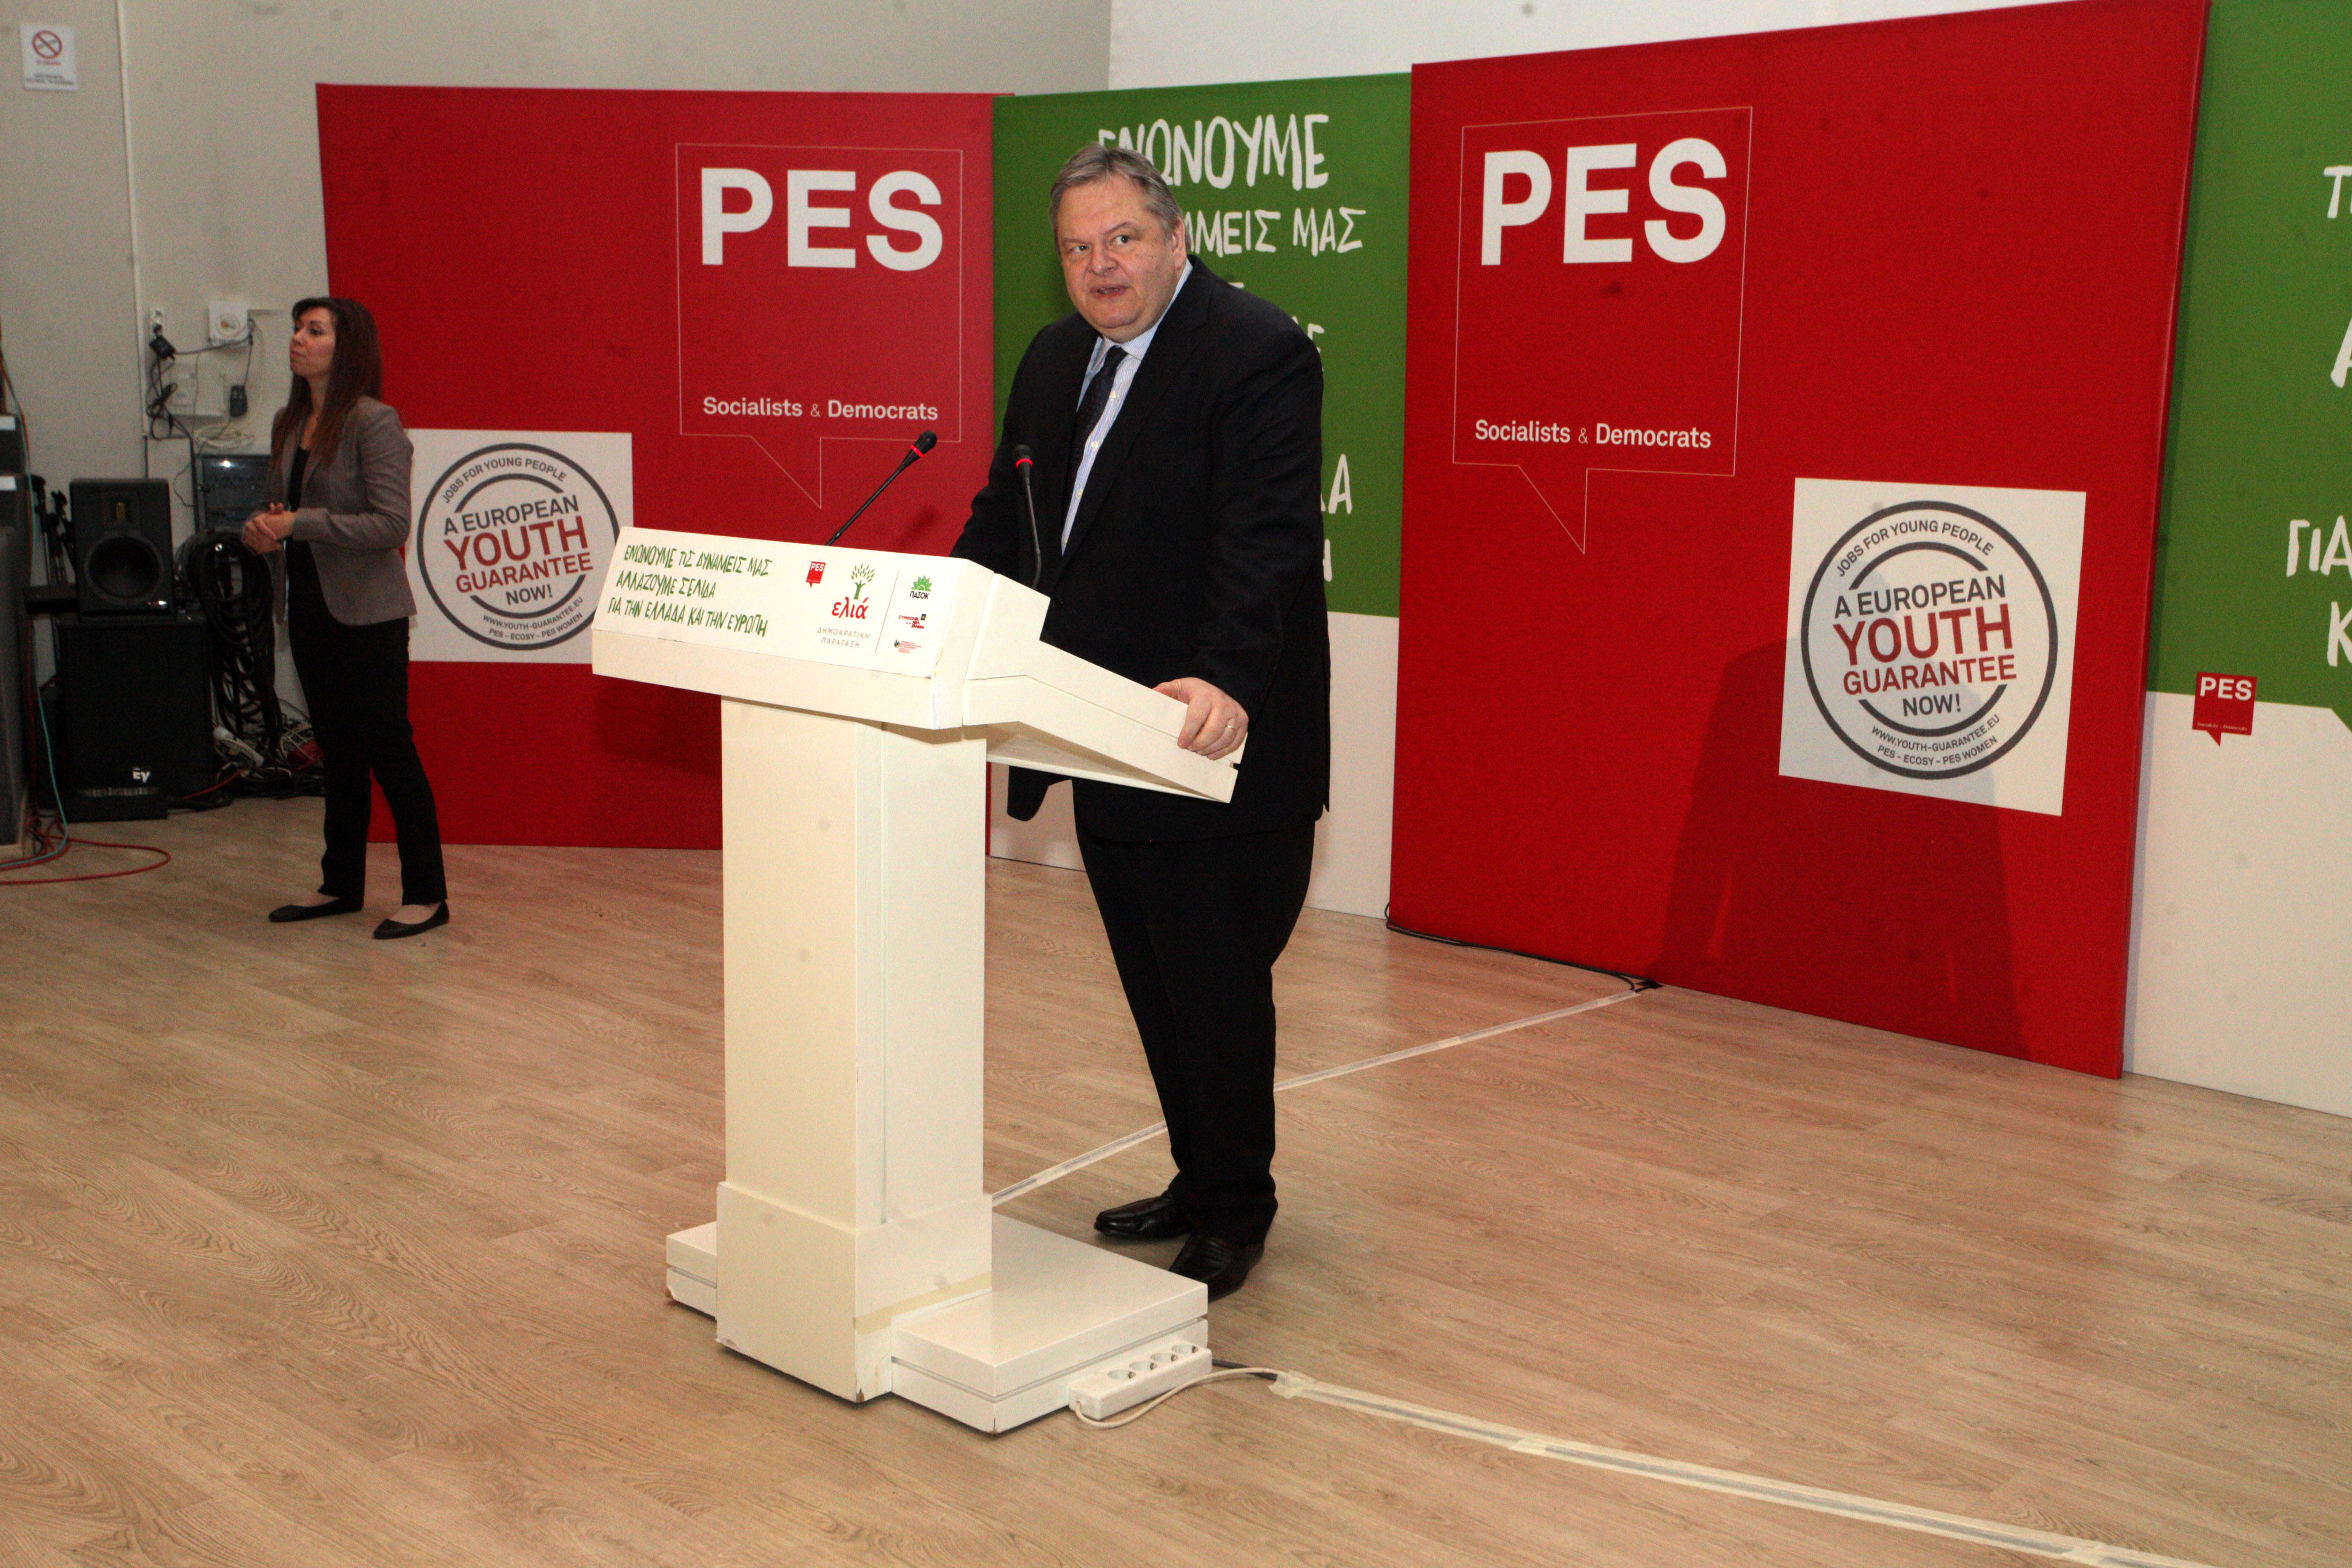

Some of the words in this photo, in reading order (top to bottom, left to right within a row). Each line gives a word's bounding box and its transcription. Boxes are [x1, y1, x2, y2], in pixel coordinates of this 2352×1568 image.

[1482, 138, 1727, 266] PES
[702, 168, 943, 272] PES
[1293, 207, 1366, 256] ΜΑΣ
[703, 397, 802, 417] Socialists
[811, 404, 821, 417] &
[828, 399, 938, 421] Democrats
[1475, 419, 1571, 443] Socialists
[1578, 428, 1589, 444] &
[1596, 423, 1712, 448] Democrats
[442, 478, 464, 503] JOBS
[462, 465, 484, 482] FOR
[483, 457, 522, 470] YOUNG
[525, 458, 567, 481] PEOPLE
[444, 518, 458, 536] A
[462, 495, 579, 532] EUROPEAN
[443, 515, 588, 571] YOUTH
[1837, 545, 1864, 576] JOBS
[1863, 528, 1890, 550] FOR
[1890, 520, 1938, 536] YOUNG
[1942, 522, 1994, 556] PEOPLE
[456, 552, 594, 593] GUARANTEE
[624, 544, 677, 568] ΕΝΩΝΟΥΜΕ
[696, 552, 747, 574] ΔΥΝΑΜΕΙΣ
[747, 557, 773, 577] ΜΑΣ
[811, 563, 825, 571] PES
[506, 584, 553, 605] NOW!
[616, 570, 677, 597] ΑΛΛΑΖΟΥΜΕ
[679, 577, 716, 598] ΣΕΛΙΔΑ
[909, 591, 930, 600] ΠΑΣΟΚ
[1834, 595, 1852, 619] A
[1857, 574, 2006, 616] EUROPEAN
[483, 596, 583, 630] WWW.YOUTH-GUARANTEE.EU
[489, 628, 504, 638] PES
[541, 629, 556, 638] PES
[556, 612, 583, 632] WOMEN
[608, 597, 622, 615] ΓΙΑ
[625, 600, 644, 618] ΤΗΝ
[644, 601, 686, 623] ΕΛΛΑΔΑ
[687, 606, 705, 627] ΚΑΙ
[705, 611, 729, 629] ΤΗΝ
[727, 613, 768, 638] ΕΥΡΩΠΗ
[831, 597, 869, 620] ελιά
[817, 627, 870, 640] ΔΗΜΟΚΡΑΤΙΚΗ
[821, 637, 860, 649] ΠΑΡΑΤΑΞΗ
[1833, 604, 2012, 666] YOUTH
[1844, 654, 2016, 695] GUARANTEE
[2200, 677, 2252, 701] PES
[1902, 693, 1961, 717] NOW!
[1872, 713, 2000, 752] WWW.YOUTH-GUARANTEE.EU
[1878, 745, 1895, 759] PES
[1904, 755, 1934, 766] ECOSY
[1943, 755, 1961, 765] PES
[1962, 736, 1998, 760] WOMEN
